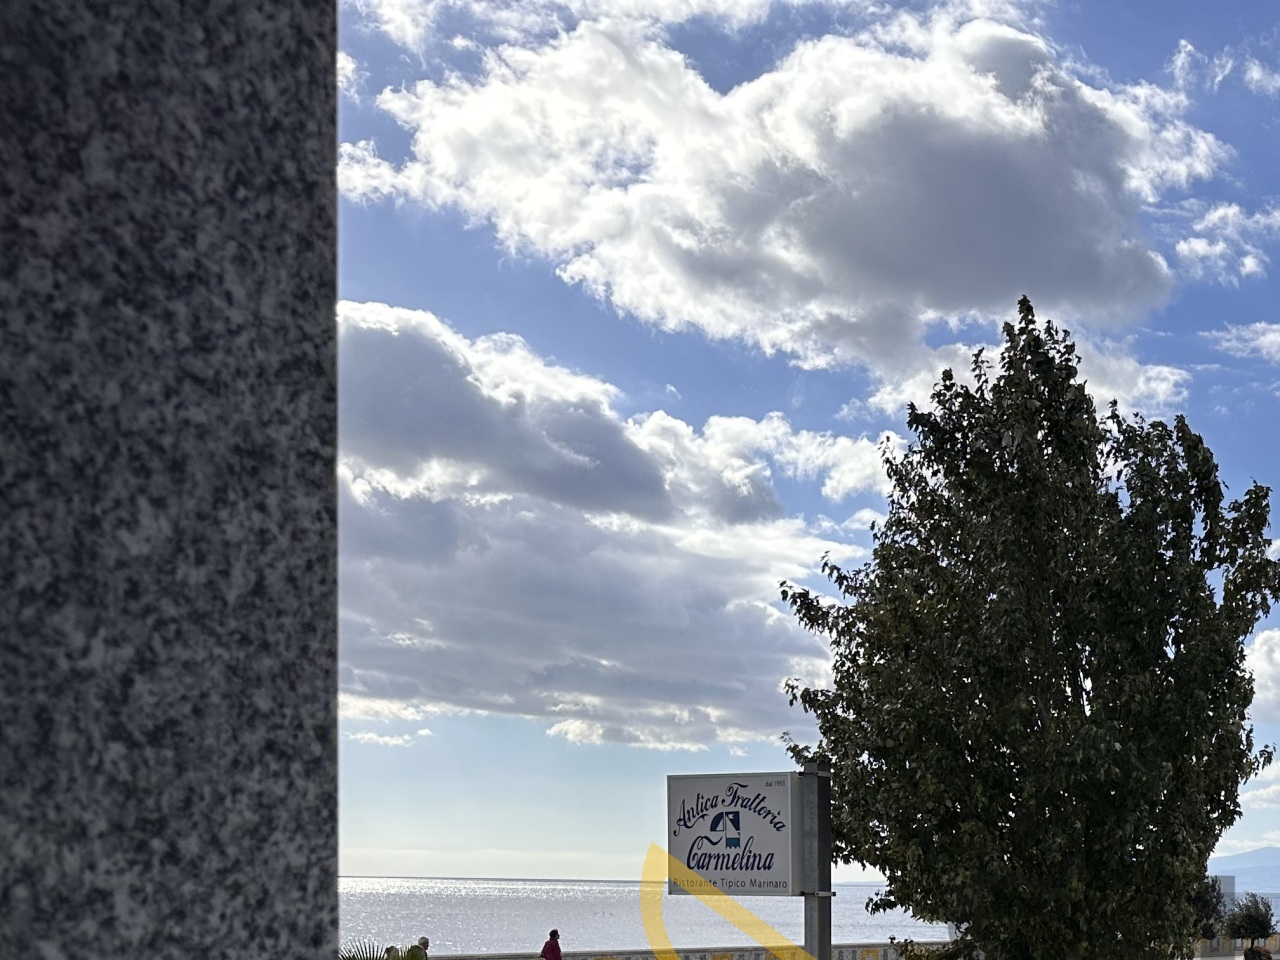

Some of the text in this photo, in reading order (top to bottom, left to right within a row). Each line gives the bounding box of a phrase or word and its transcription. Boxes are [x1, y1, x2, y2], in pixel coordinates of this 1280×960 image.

[673, 782, 786, 837] Antica Trattoria
[686, 835, 775, 871] Carmelina
[673, 877, 788, 890] Ristorante Tipico Marinaro
